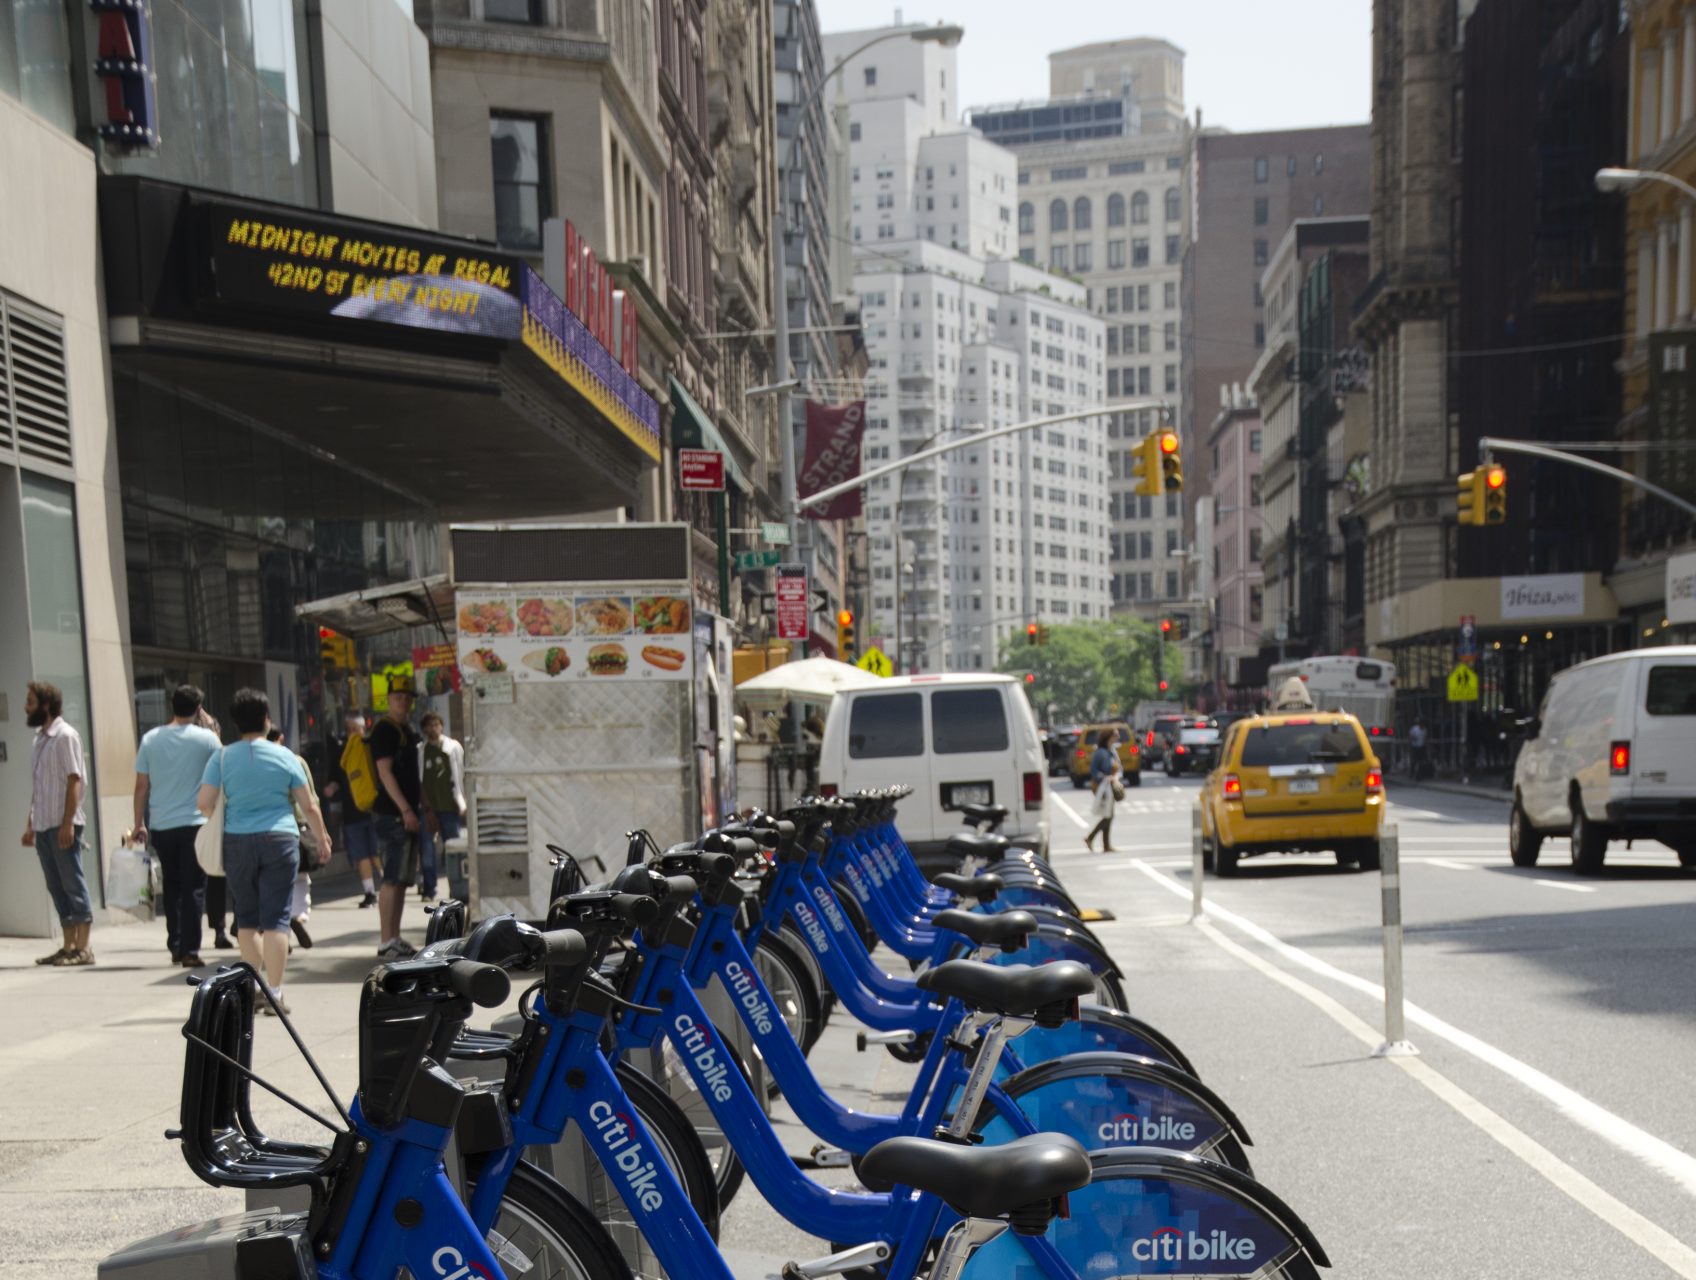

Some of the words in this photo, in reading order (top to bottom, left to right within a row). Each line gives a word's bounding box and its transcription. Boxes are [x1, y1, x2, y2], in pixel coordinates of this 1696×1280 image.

[227, 218, 339, 260] MIDNIGHT
[341, 239, 421, 275] MOVIES
[423, 253, 447, 277] AT
[452, 256, 511, 290] REGAL
[267, 261, 324, 293] 42ND
[324, 269, 350, 296] ST
[351, 273, 413, 305] EVERY
[803, 405, 862, 490] STRAND
[794, 901, 817, 926] citi
[805, 921, 829, 954] bike
[725, 961, 756, 995] citi
[741, 990, 773, 1036] bike
[674, 1014, 711, 1055] citi
[694, 1048, 733, 1103] bike
[589, 1101, 636, 1151] citi
[614, 1143, 663, 1212] bike
[1098, 1113, 1138, 1142] citi
[1142, 1116, 1196, 1141] bike
[1131, 1226, 1184, 1261] citi
[1188, 1229, 1256, 1261] bike
